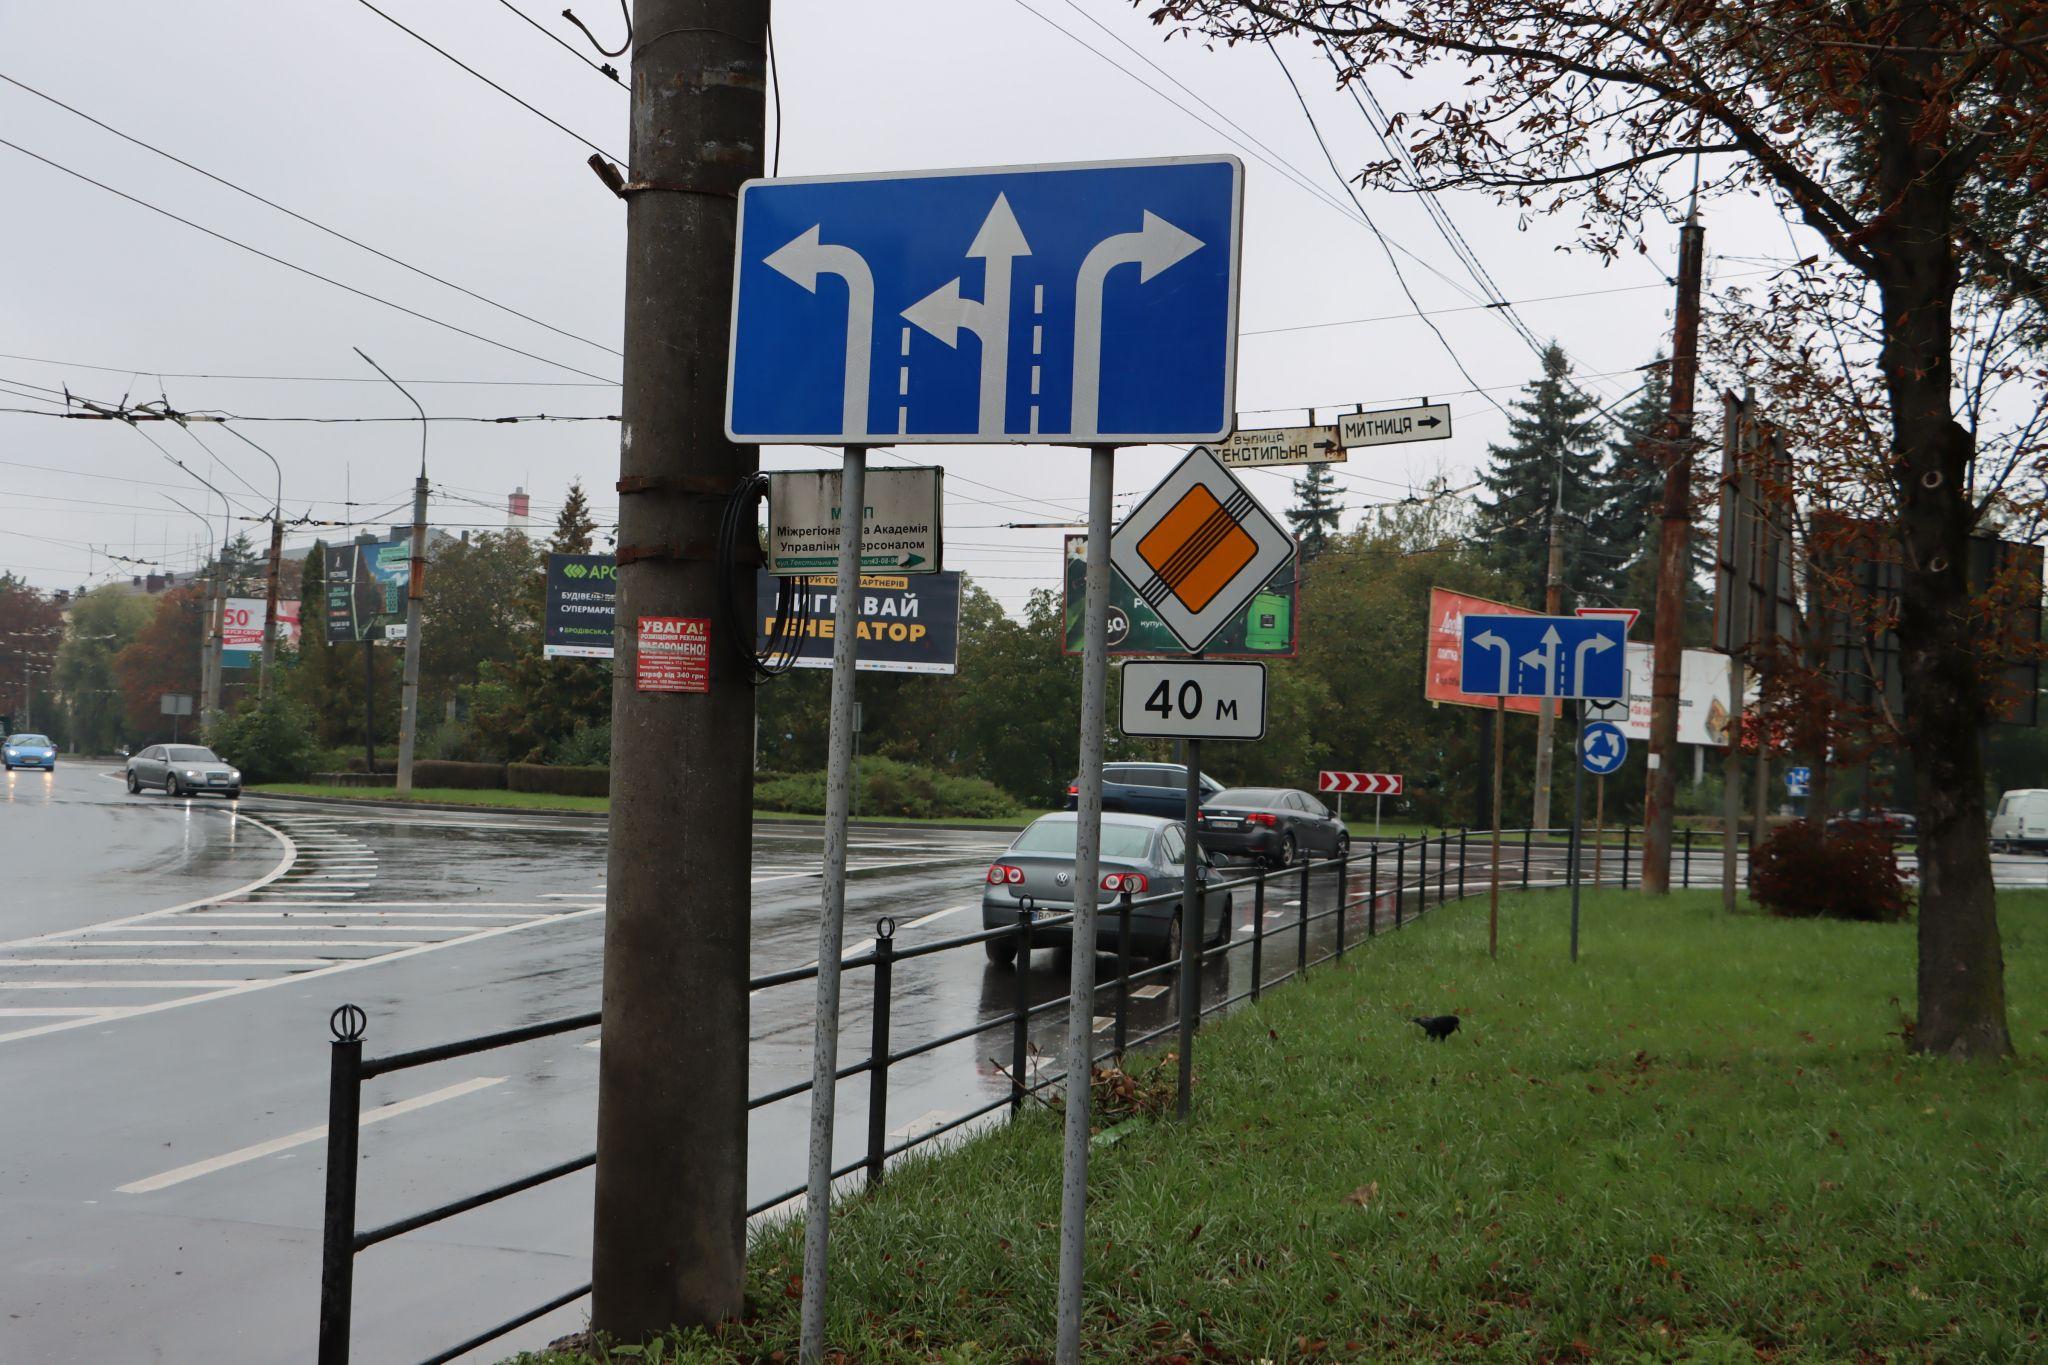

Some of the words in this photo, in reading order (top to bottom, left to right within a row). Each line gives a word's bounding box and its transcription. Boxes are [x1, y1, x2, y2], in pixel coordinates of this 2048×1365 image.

[1345, 417, 1412, 439] МИТНИЦЯ
[831, 506, 874, 520] МП
[777, 524, 870, 538] Міжрегіонаа
[874, 523, 928, 536] Академія
[780, 541, 840, 554] Управлінн
[859, 541, 925, 553] ерсоналом
[561, 605, 615, 615] СУПЕРМАРКЕ
[642, 620, 704, 634] УВАГА!
[764, 617, 927, 642] ГЕНЕАТОР
[1144, 679, 1203, 720] 40
